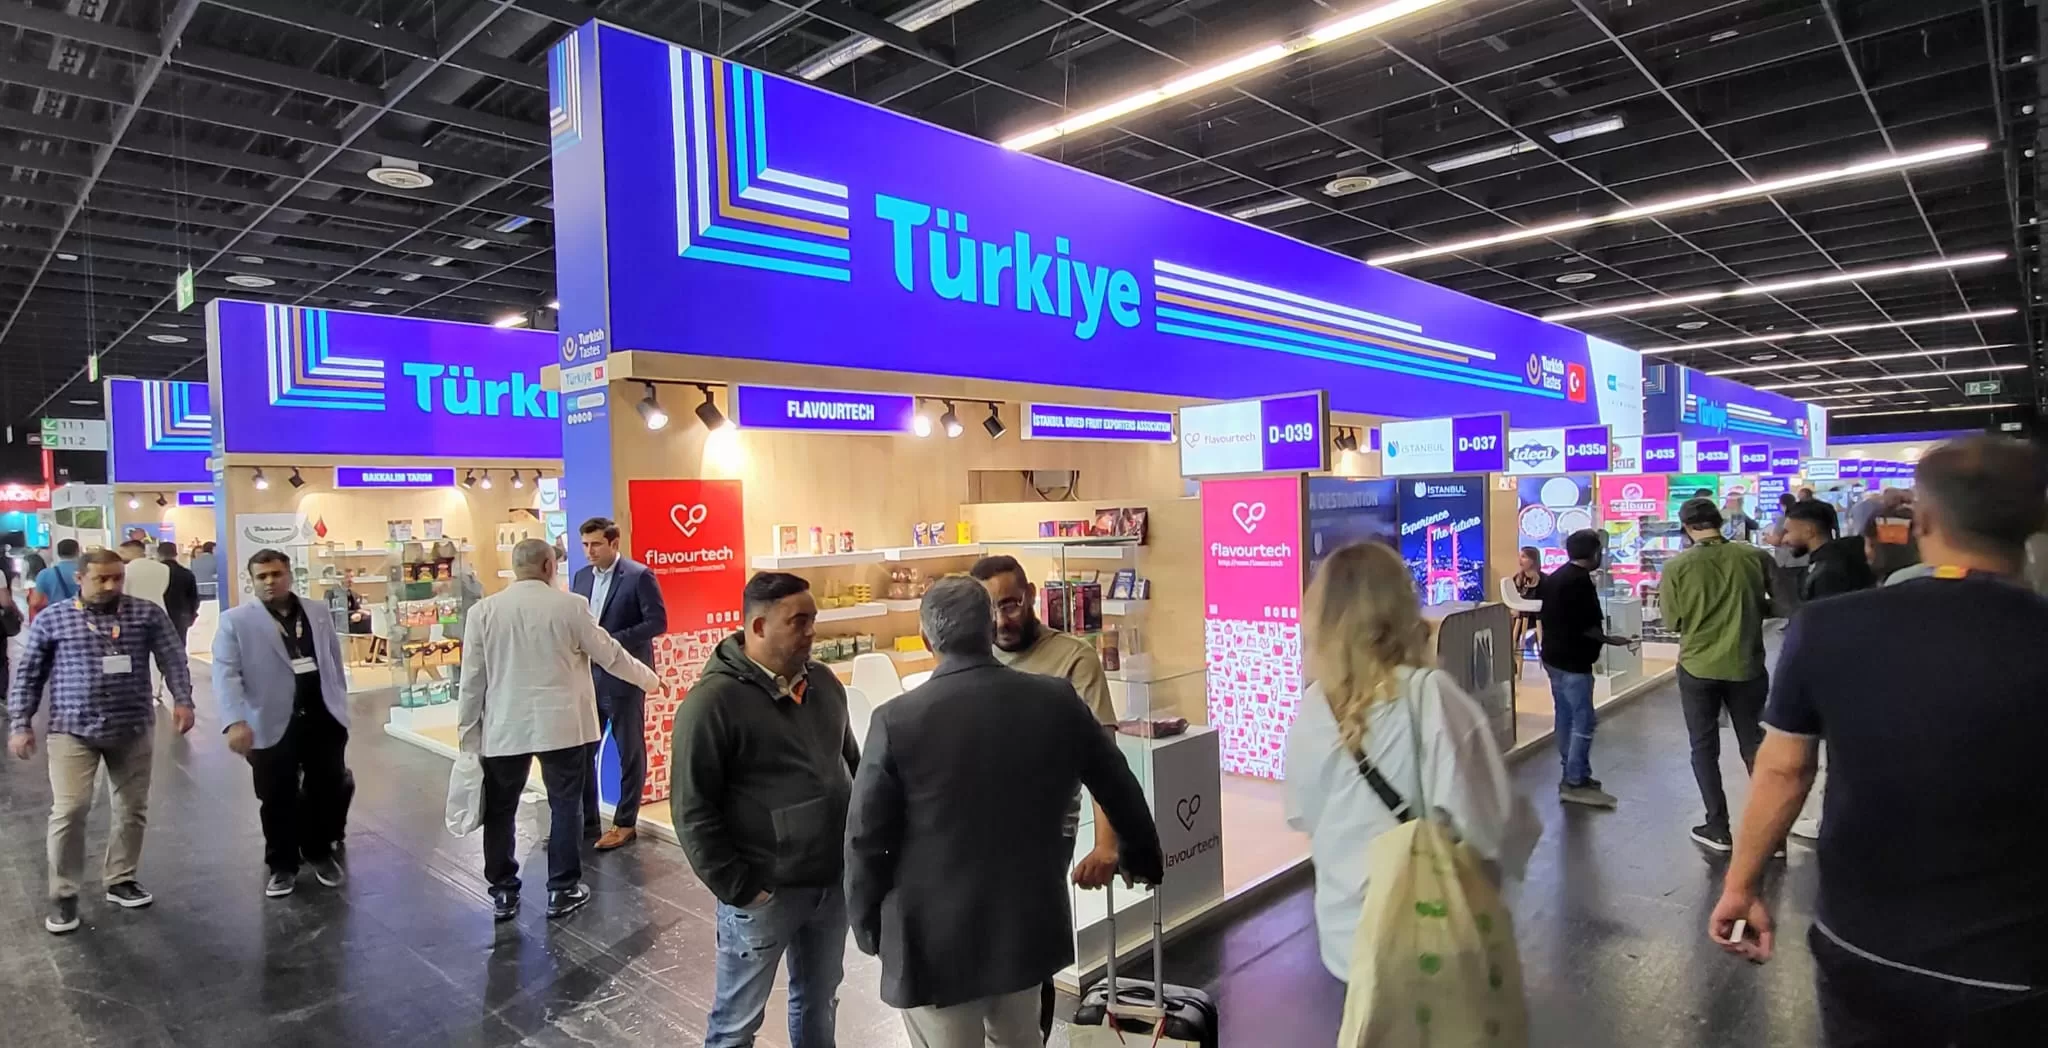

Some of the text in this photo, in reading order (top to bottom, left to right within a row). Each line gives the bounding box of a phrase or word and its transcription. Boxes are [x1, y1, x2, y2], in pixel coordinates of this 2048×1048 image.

[875, 193, 1141, 340] Türkiye
[578, 328, 605, 345] Turkish
[579, 345, 600, 359] Tastes
[1541, 355, 1565, 375] Turkish
[565, 371, 592, 385] Türkiye
[1542, 372, 1562, 391] Tastes
[403, 362, 559, 418] Türki
[787, 400, 875, 421] FLAVOURTECH
[1204, 432, 1256, 445] flavourtech
[1268, 422, 1313, 444] D-039
[1458, 435, 1497, 451] D-037
[1513, 446, 1553, 460] ideal
[1427, 484, 1467, 495] İSTANBUL
[1318, 491, 1379, 510] DESTINATION
[1401, 510, 1449, 536] Experience
[1431, 516, 1481, 541] The Future
[645, 545, 733, 565] flavourtech
[1211, 542, 1291, 557] flavourtech
[1165, 835, 1220, 868] lavourtech
